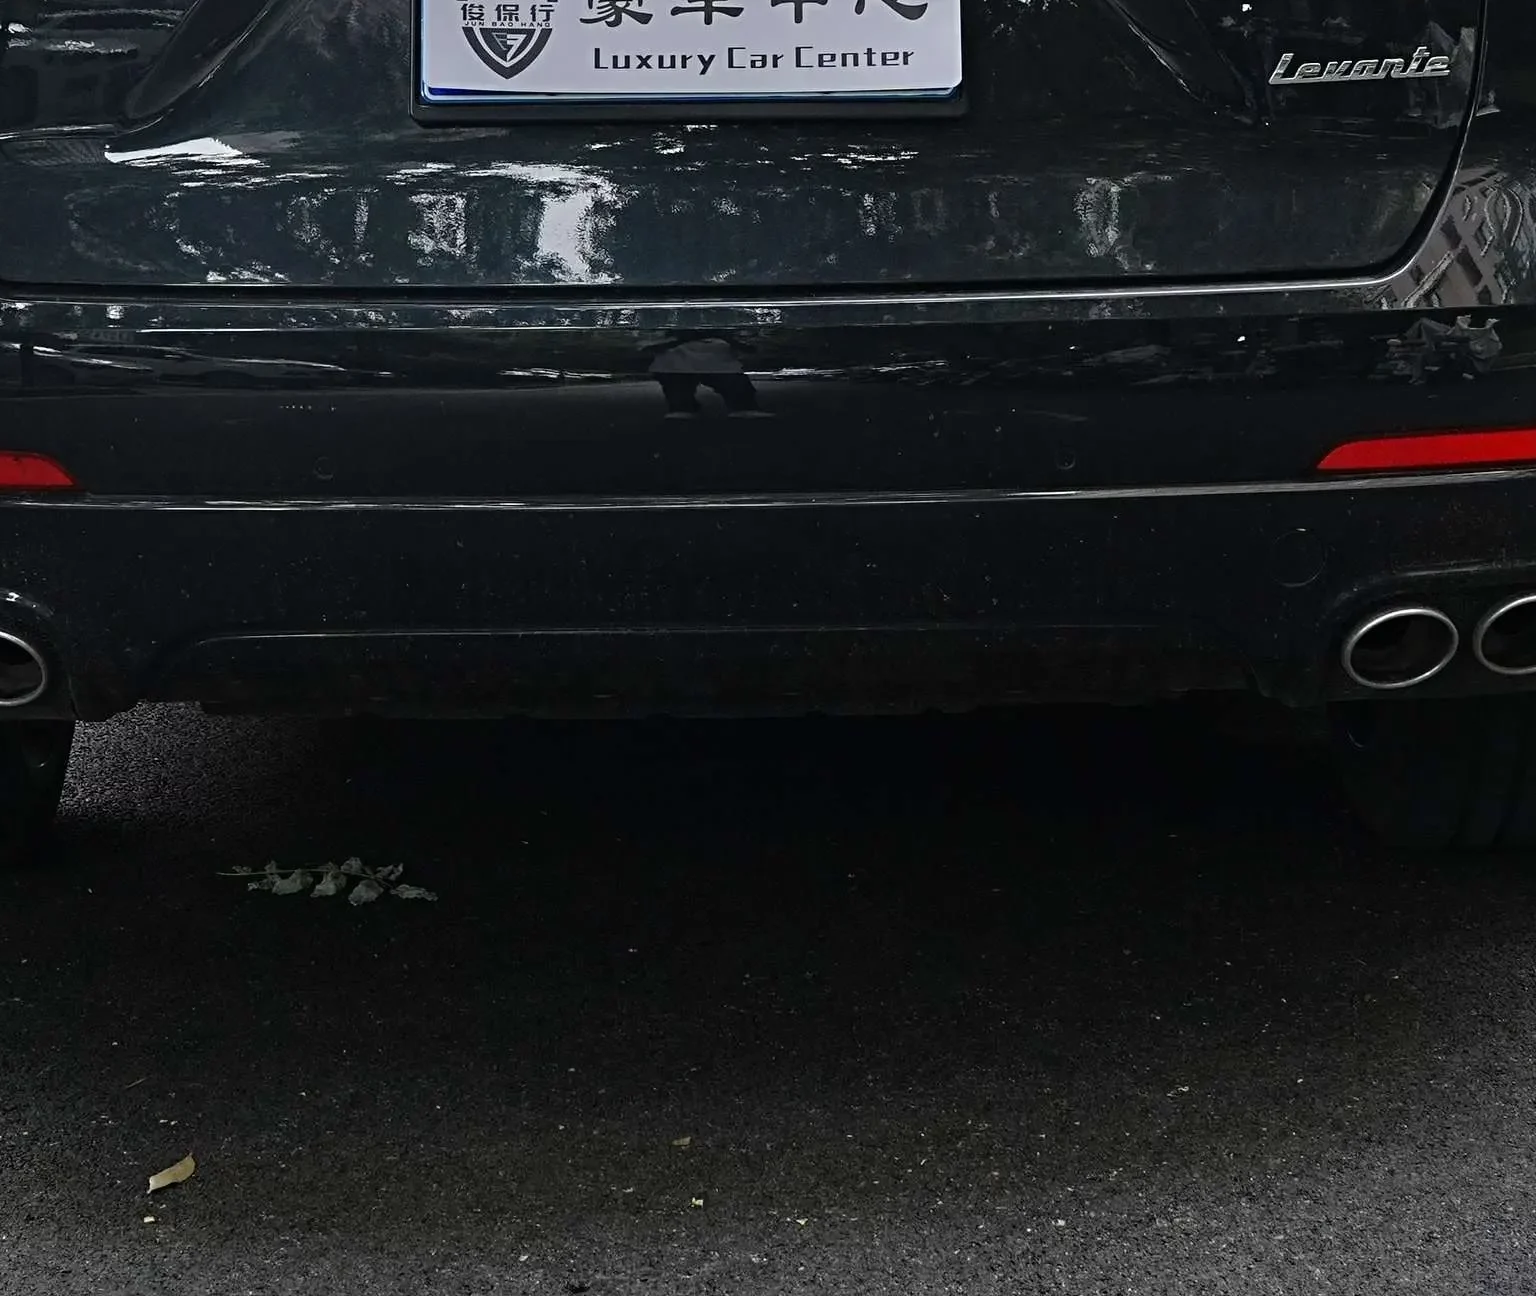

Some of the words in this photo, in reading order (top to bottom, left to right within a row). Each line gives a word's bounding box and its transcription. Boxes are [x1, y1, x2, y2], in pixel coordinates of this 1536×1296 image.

[460, 3, 555, 22] 俊保行
[594, 47, 716, 75] Luxury
[727, 47, 784, 69] Car
[795, 46, 914, 69] Center
[1269, 46, 1450, 85] Levante
